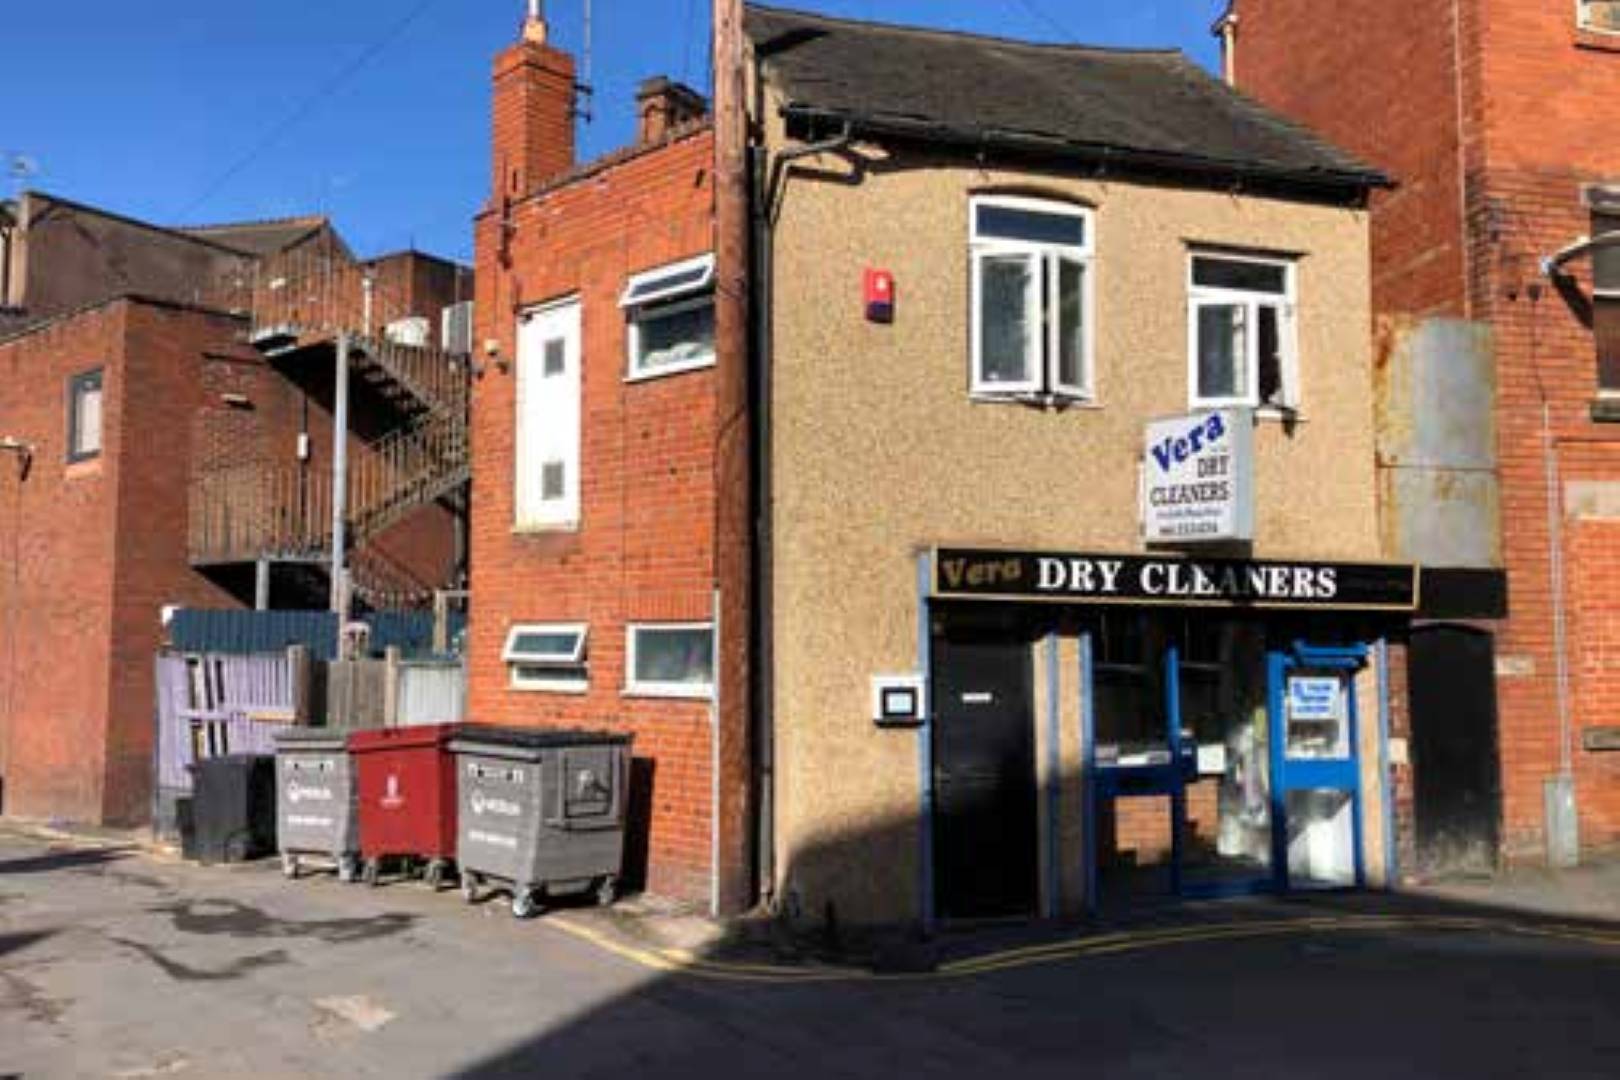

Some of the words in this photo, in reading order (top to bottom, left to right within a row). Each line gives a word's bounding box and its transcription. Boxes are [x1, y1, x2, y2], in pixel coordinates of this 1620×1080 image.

[1152, 412, 1225, 472] Vera
[1198, 455, 1230, 478] DRY
[1150, 480, 1228, 507] CLEANERS
[942, 558, 1021, 588] Vera
[1036, 557, 1121, 592] DRY
[1139, 562, 1337, 598] CLEANERS
